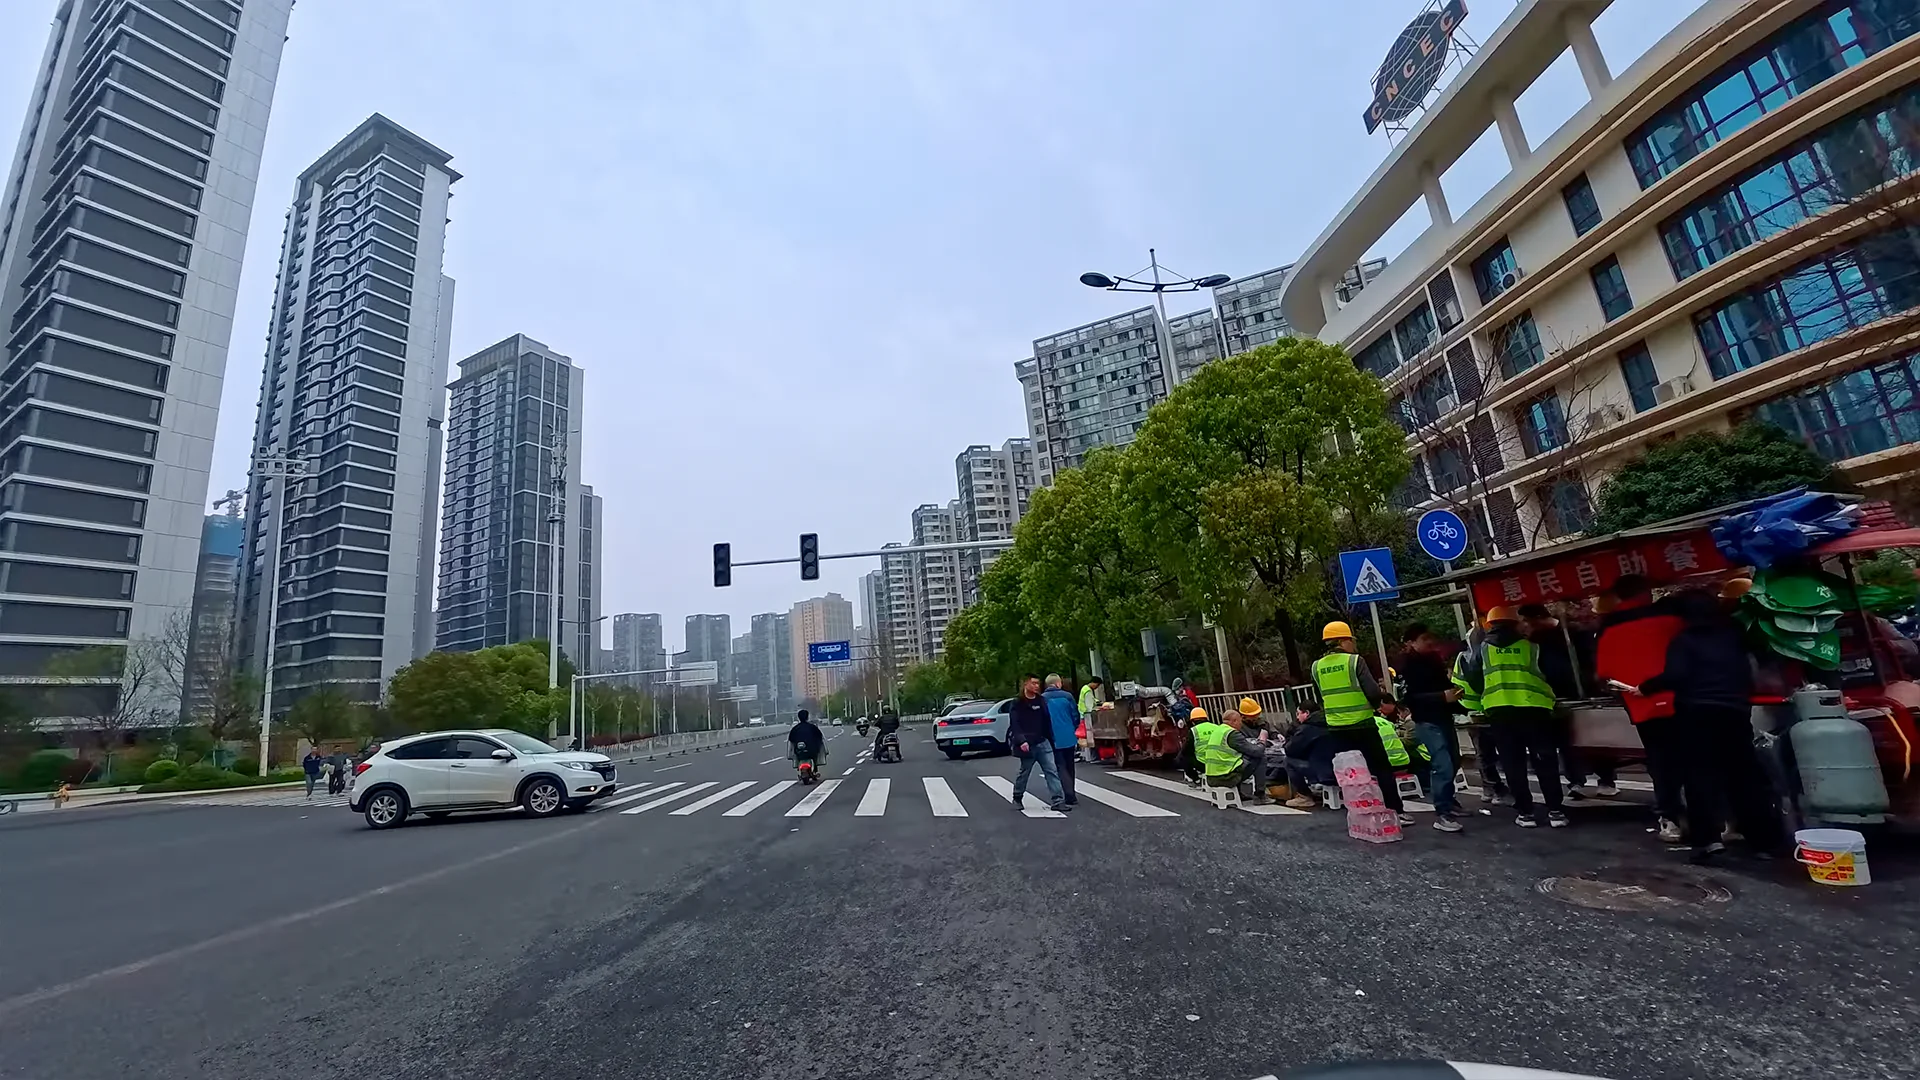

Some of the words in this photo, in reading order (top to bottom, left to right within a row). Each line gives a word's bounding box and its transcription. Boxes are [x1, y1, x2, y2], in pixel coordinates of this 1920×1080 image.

[1371, 10, 1454, 120] CNCEC
[1500, 540, 1700, 602] 惠民自助餐
